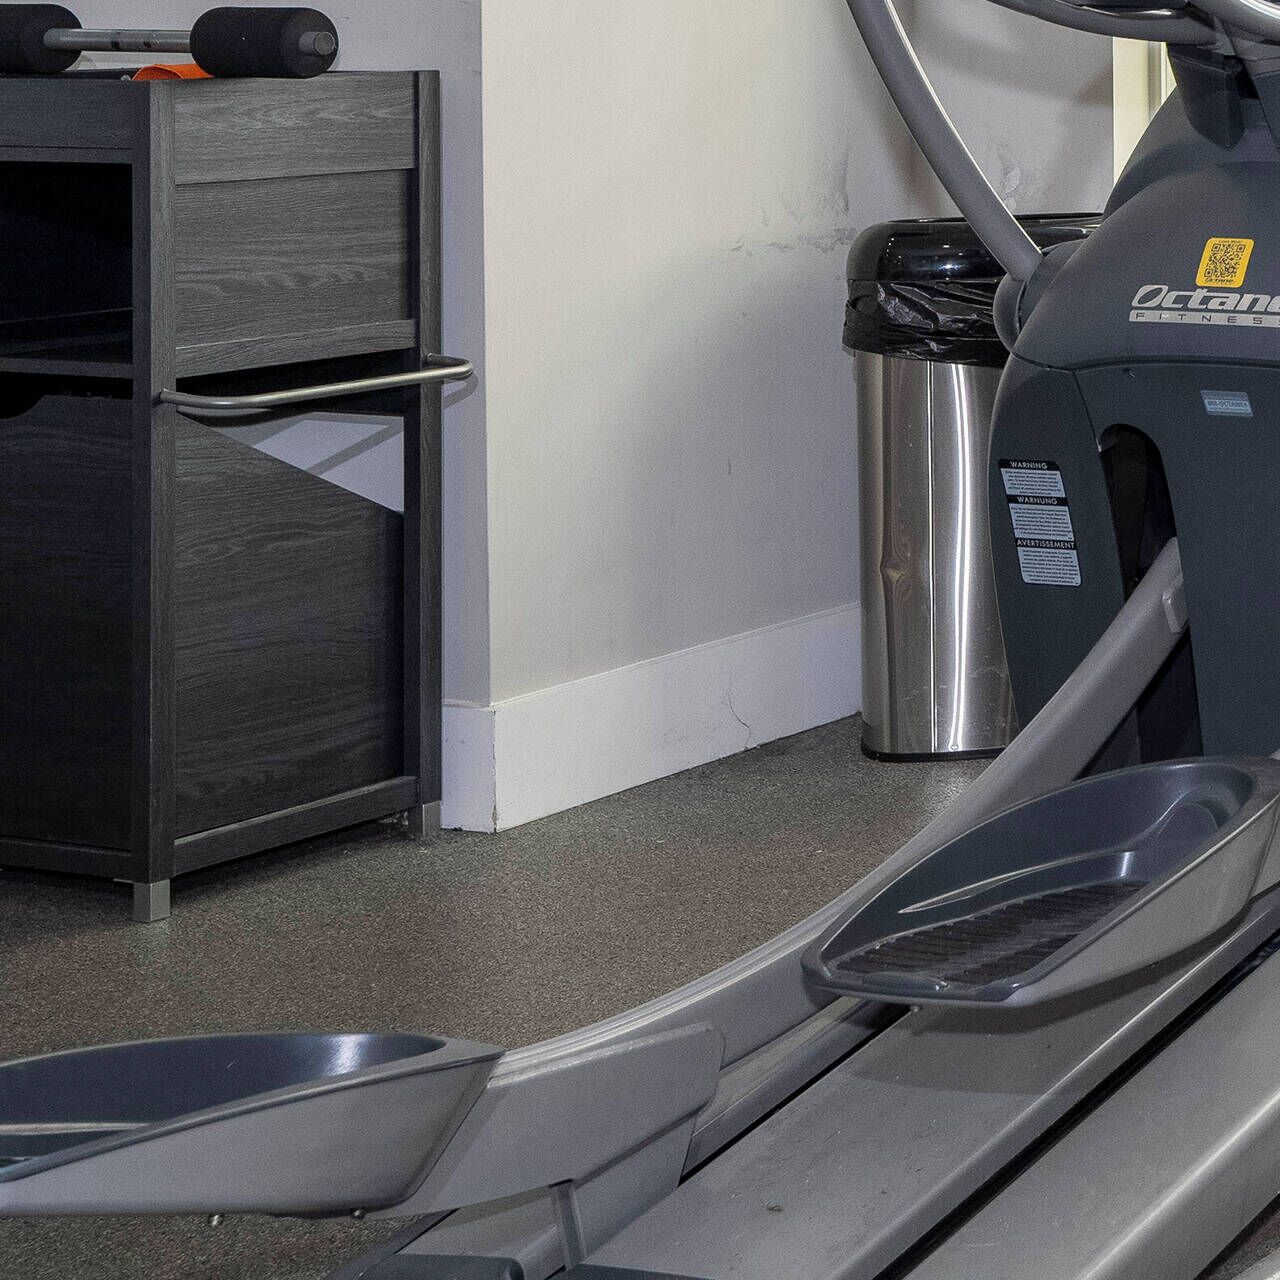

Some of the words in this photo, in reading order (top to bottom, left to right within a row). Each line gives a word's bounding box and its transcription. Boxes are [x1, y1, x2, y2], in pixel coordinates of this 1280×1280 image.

[1010, 461, 1048, 469] WARNING
[1017, 496, 1057, 505] WARNUNG
[1017, 540, 1074, 549] AVERTISSEMENT
